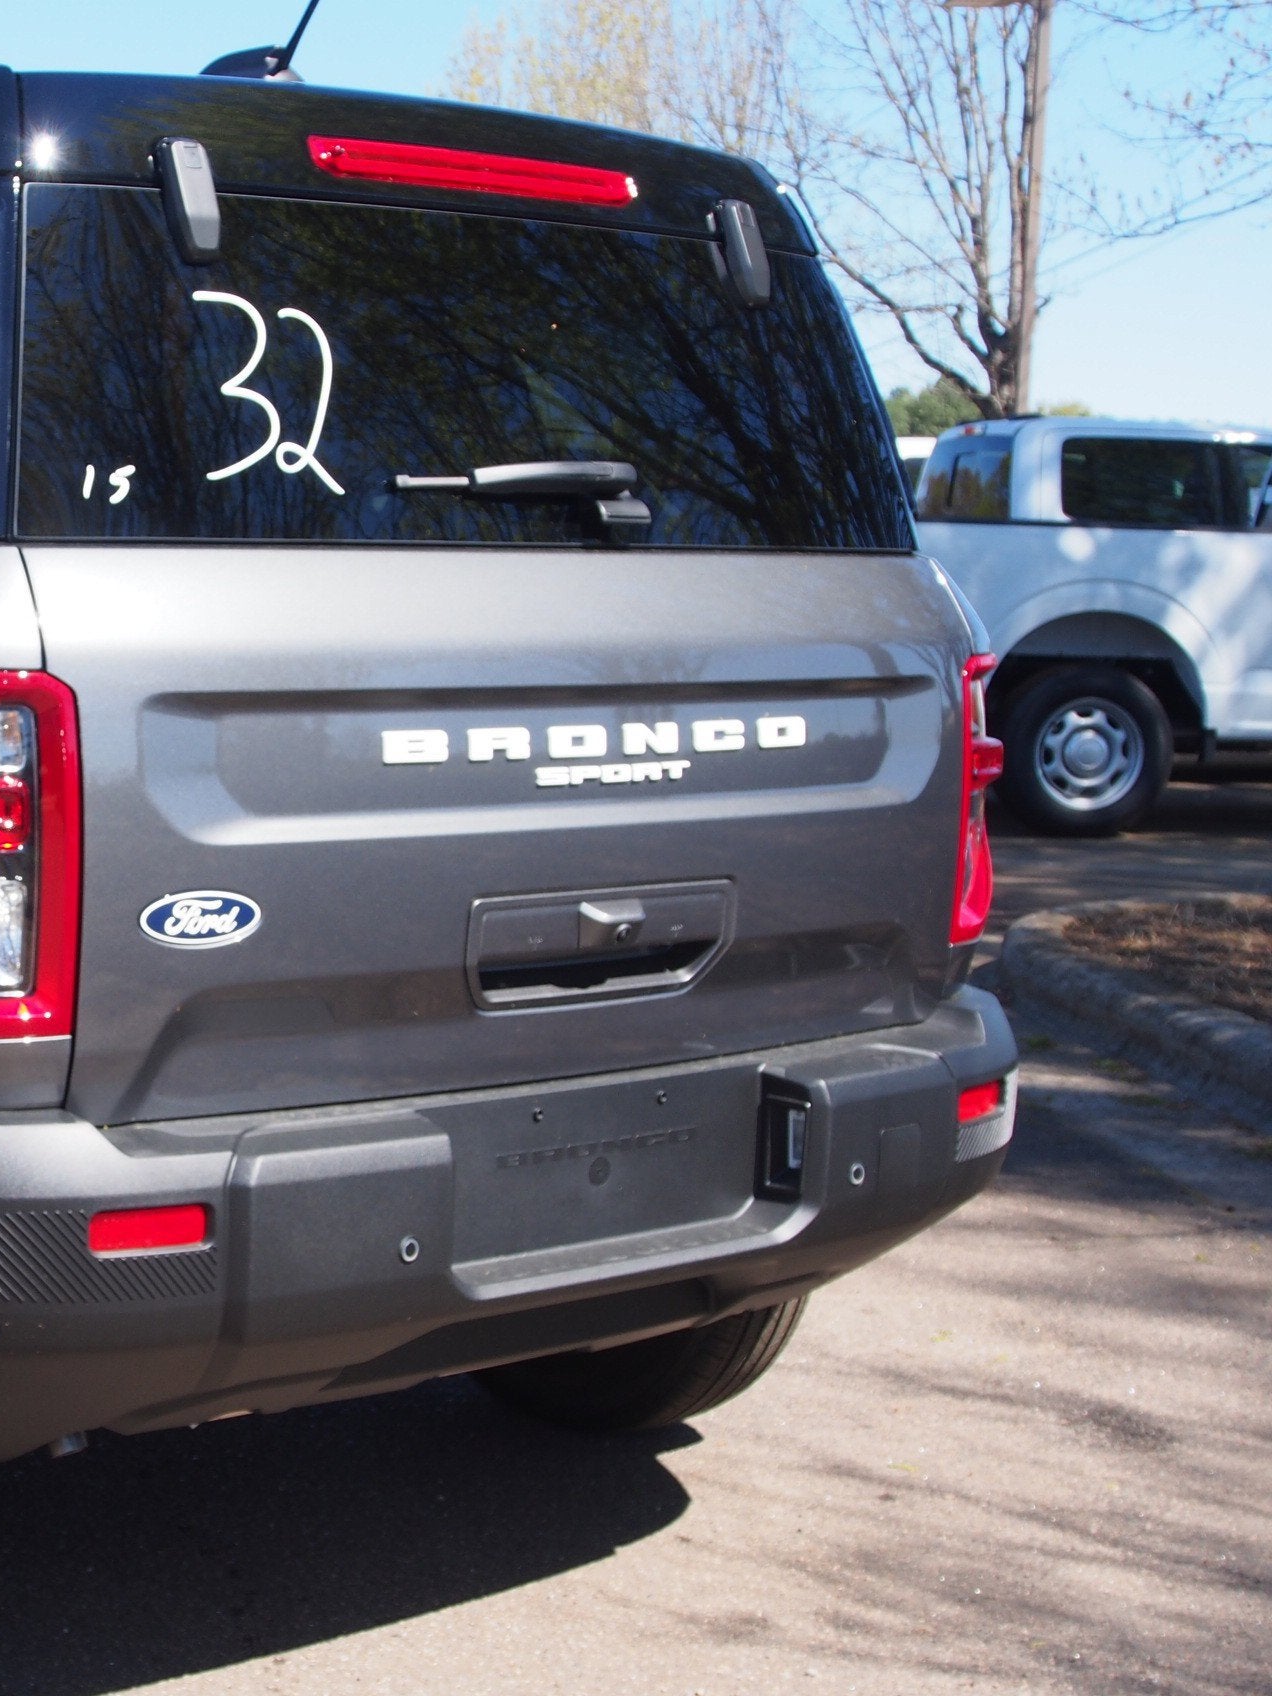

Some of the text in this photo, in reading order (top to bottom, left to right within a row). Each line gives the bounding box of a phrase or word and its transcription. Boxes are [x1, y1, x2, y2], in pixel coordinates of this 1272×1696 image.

[191, 289, 345, 495] 32
[82, 464, 136, 504] 15
[381, 715, 807, 764] BRONCO
[535, 759, 691, 787] SPORT
[163, 899, 241, 936] Ford
